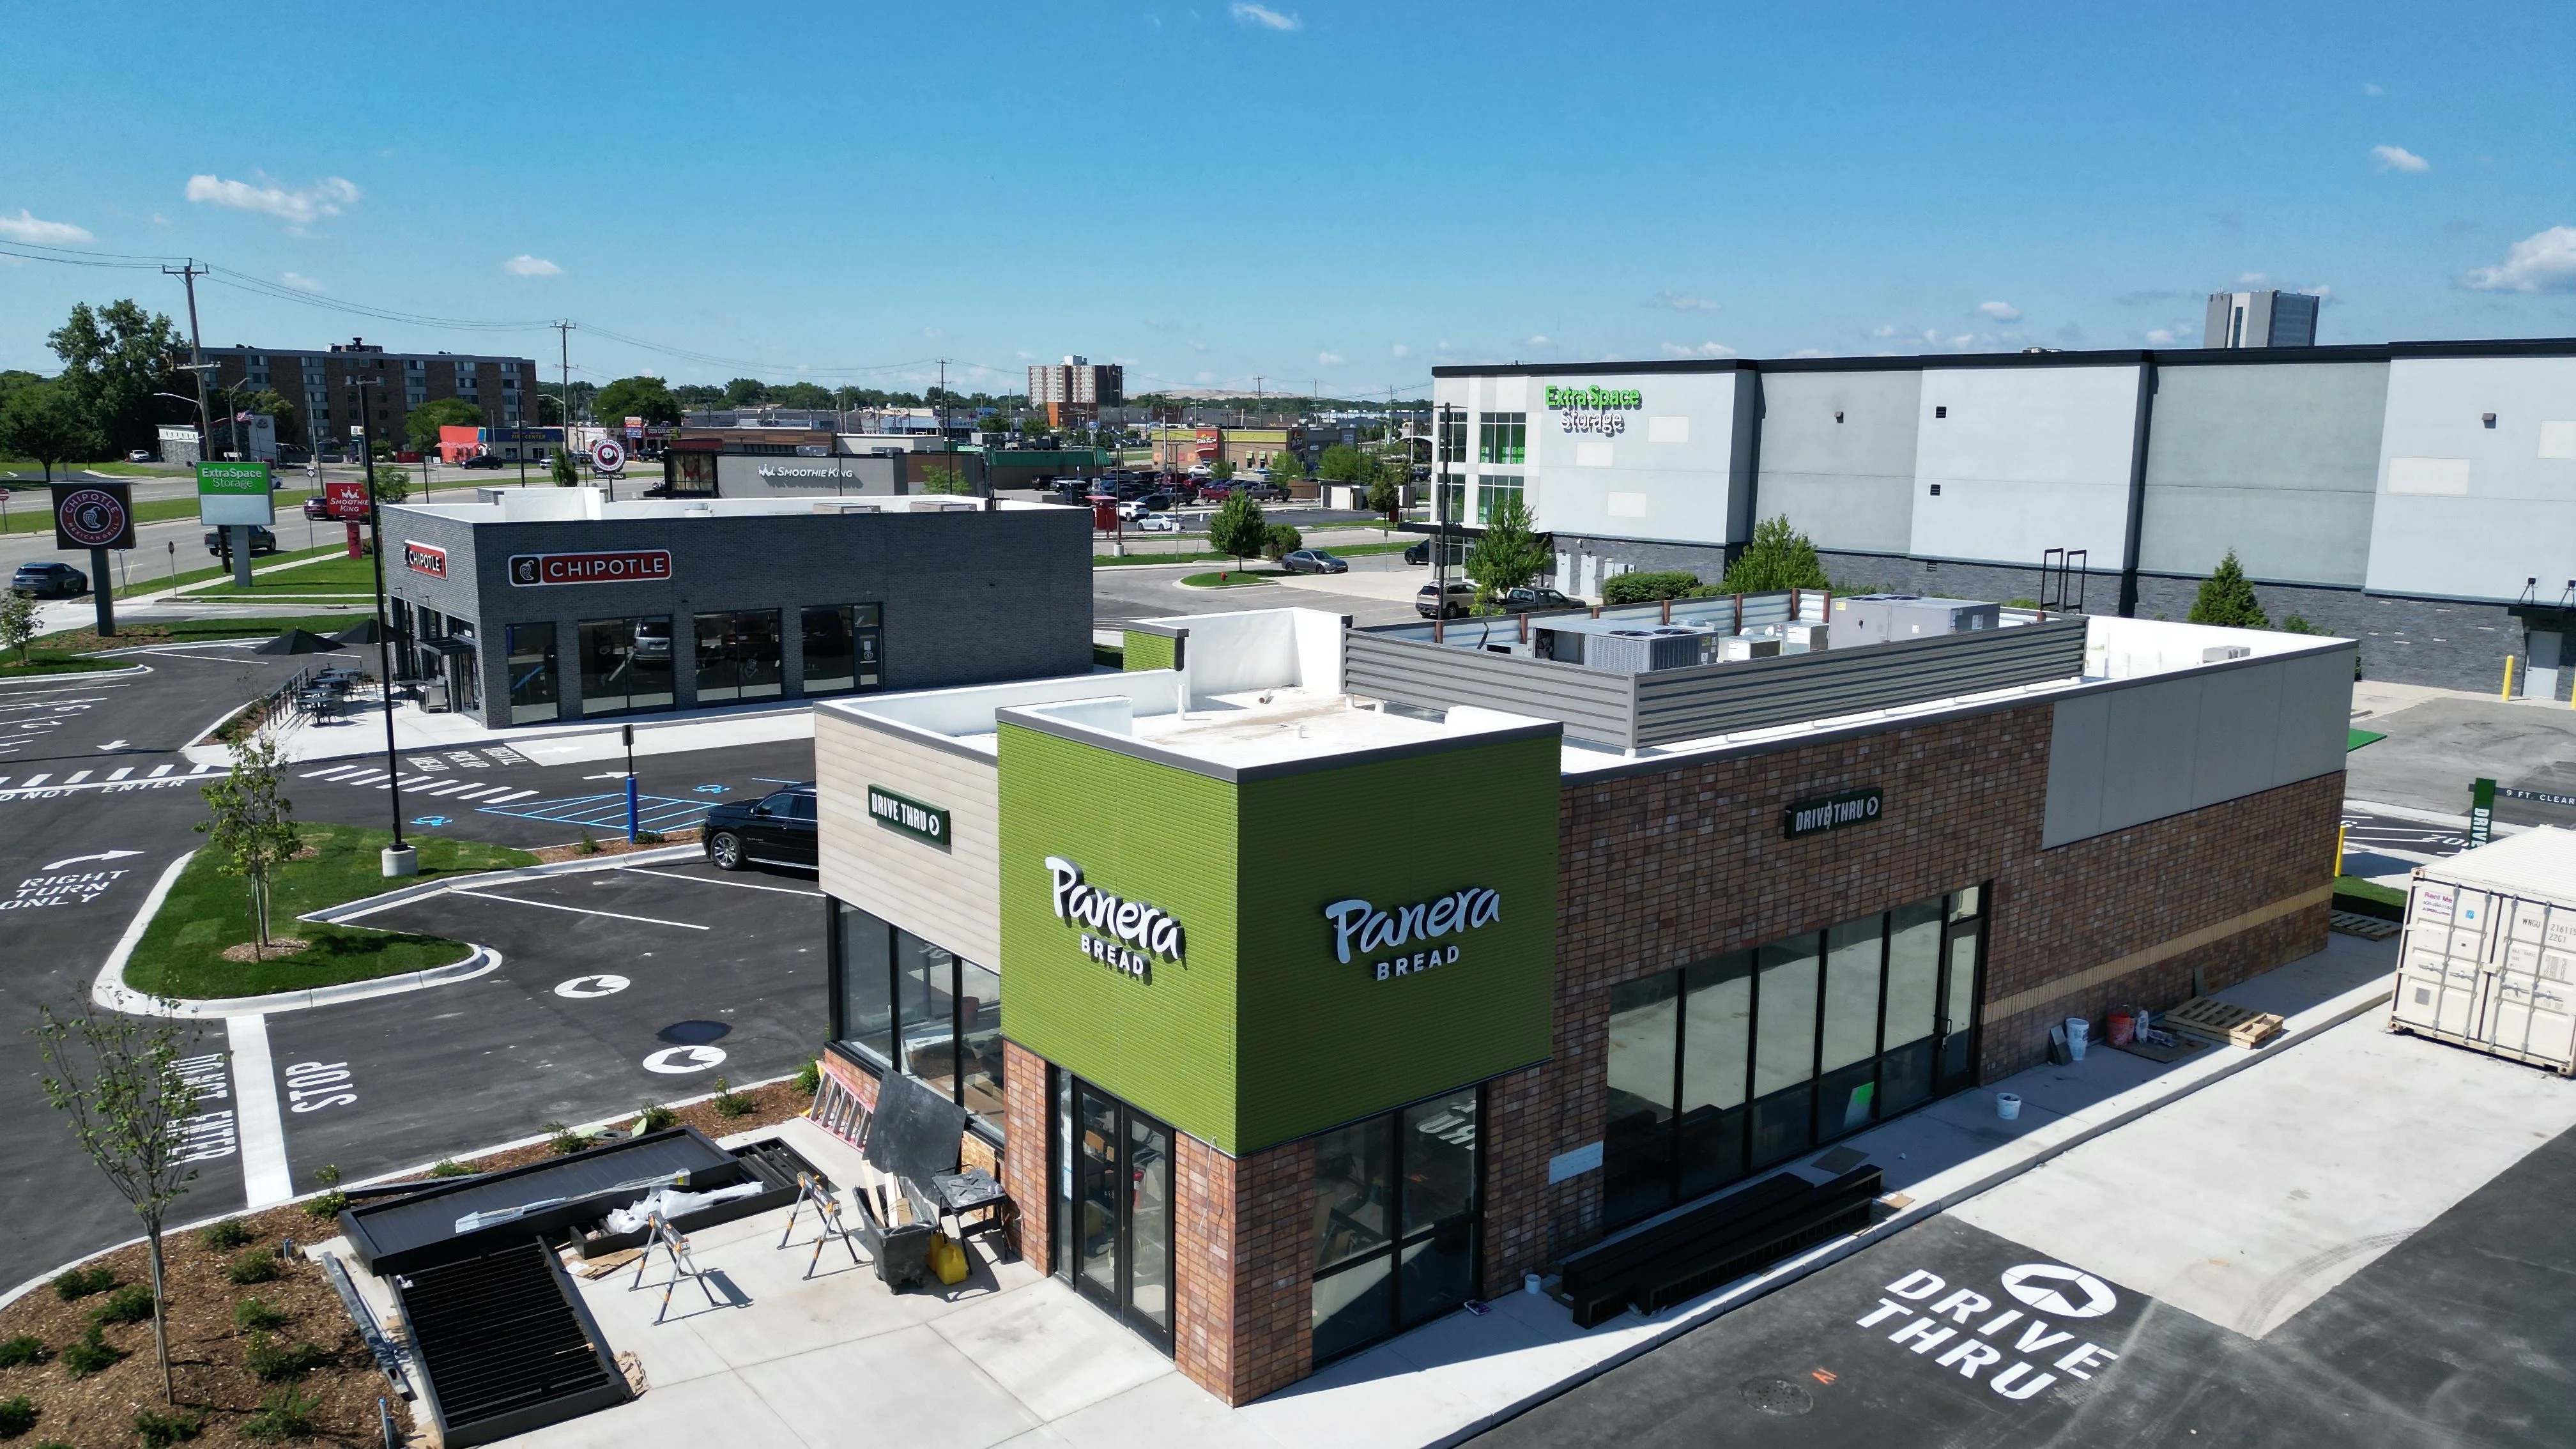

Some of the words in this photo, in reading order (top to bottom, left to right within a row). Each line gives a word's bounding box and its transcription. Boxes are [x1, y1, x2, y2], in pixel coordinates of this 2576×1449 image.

[1560, 408, 1623, 433] Storage
[777, 466, 827, 477] SMOOTHIE
[828, 467, 854, 478] KING
[213, 477, 254, 489] Storage
[65, 493, 119, 514] CHIPOTLE
[68, 522, 101, 540] MEXICAN
[409, 550, 440, 572] CHIPOTLE
[549, 558, 666, 578] CHIPOTLE
[406, 756, 450, 772] AHEAD
[480, 746, 528, 765] DIGITAL
[21, 789, 80, 800] NOT
[101, 779, 186, 793] ENTER
[871, 792, 899, 822] DRIVE
[900, 803, 926, 832] THRU
[1795, 805, 1832, 832] DRIVE
[1834, 799, 1864, 824] THRU
[2471, 808, 2490, 848] DRIVE
[19, 870, 129, 888] RIGHT
[16, 882, 111, 898] TURN
[2424, 892, 2441, 901] Rent
[1045, 856, 1180, 960] Panera
[1325, 887, 1500, 964] Panera
[2522, 918, 2541, 928] WNGU
[2549, 933, 2566, 943] 22G1
[1080, 933, 1144, 975] BREAD
[1377, 946, 1460, 981] BREAD
[286, 1061, 358, 1113] STOP
[166, 1110, 236, 1167] ENTER
[1885, 1269, 2119, 1380] DRIVE
[1856, 1298, 2057, 1400] THRU
